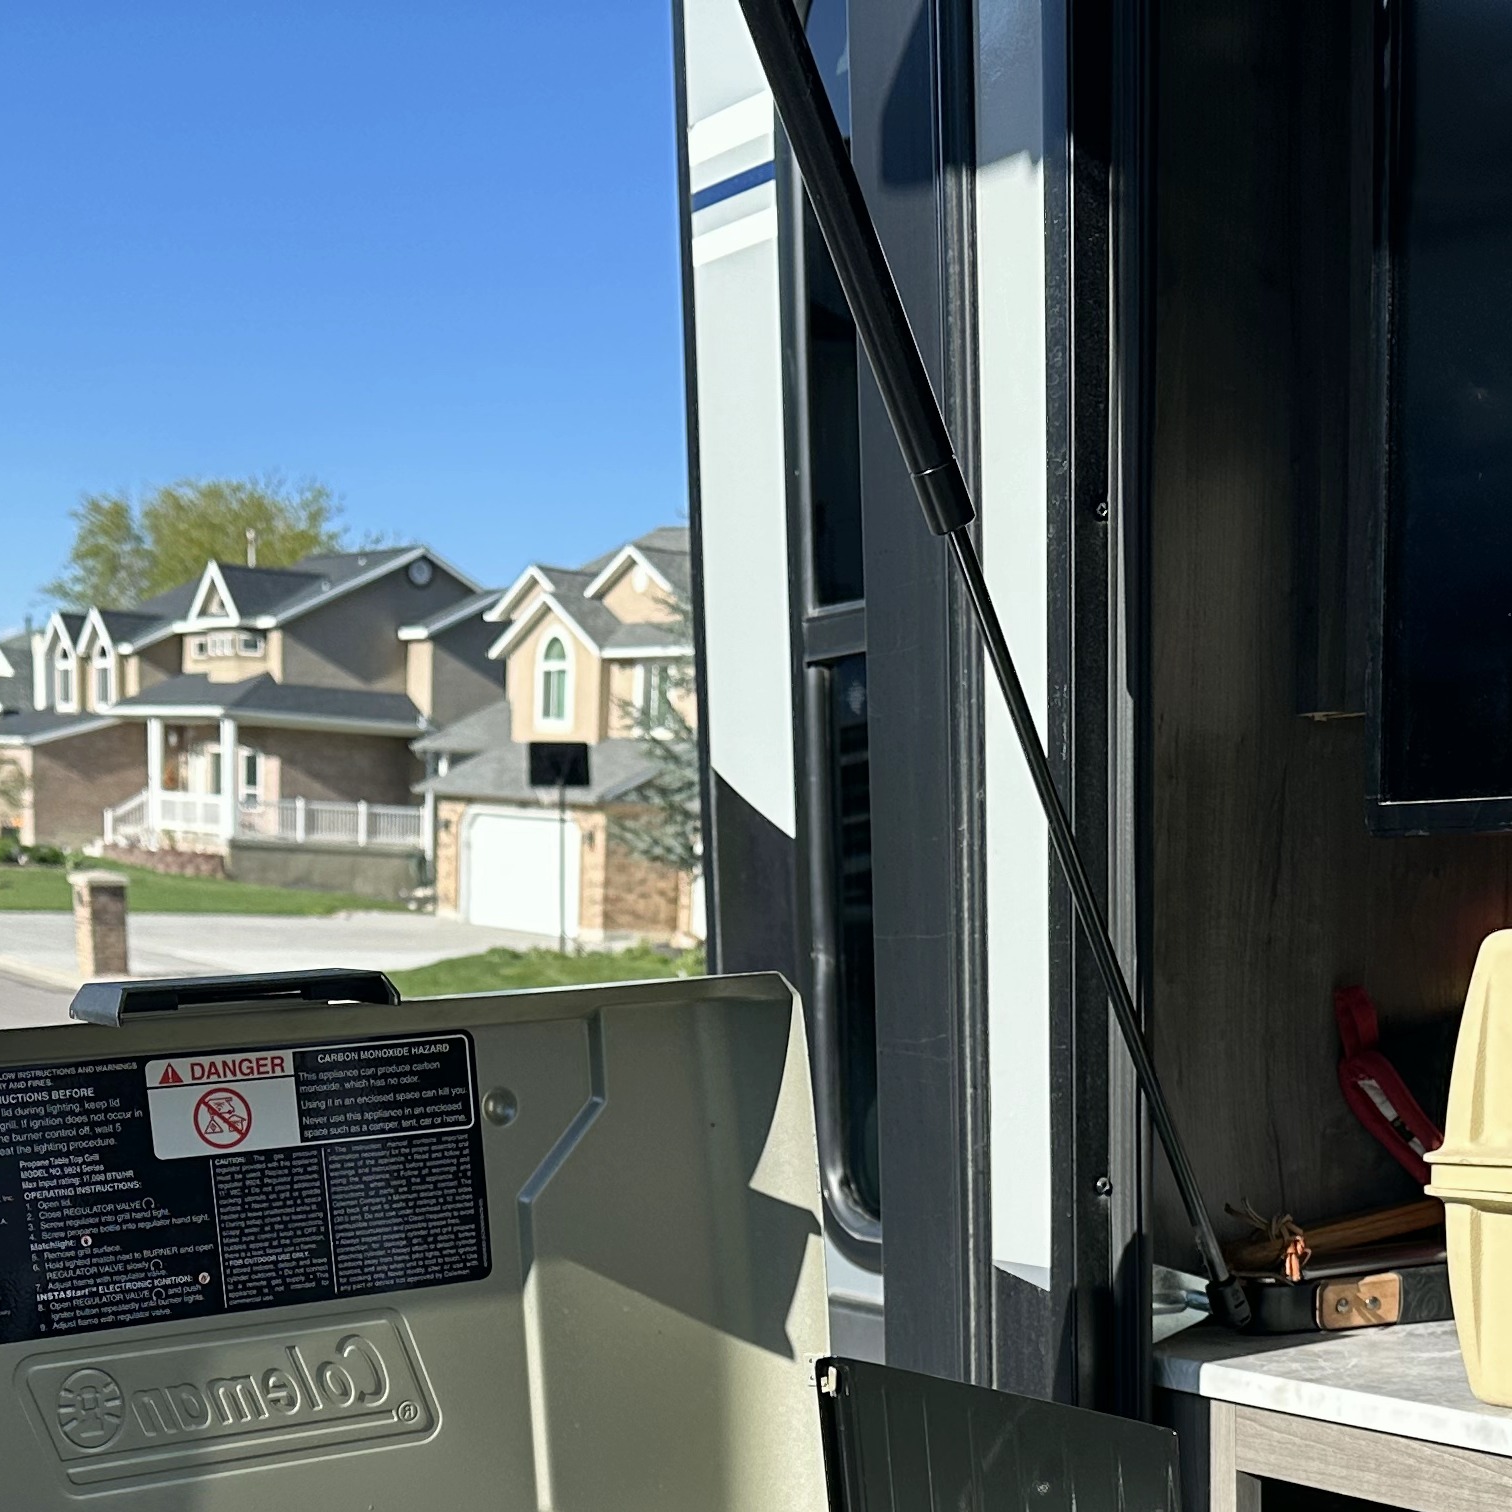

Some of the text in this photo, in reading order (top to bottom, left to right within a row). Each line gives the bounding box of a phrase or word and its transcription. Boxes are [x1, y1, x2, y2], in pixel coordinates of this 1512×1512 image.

[317, 1043, 450, 1064] CARBON MONOXIDE HAZARD
[190, 1056, 285, 1081] DANGER
[51, 1087, 95, 1100] BEFORE
[24, 1180, 142, 1200] OPERATING INSTRUCTIONS:
